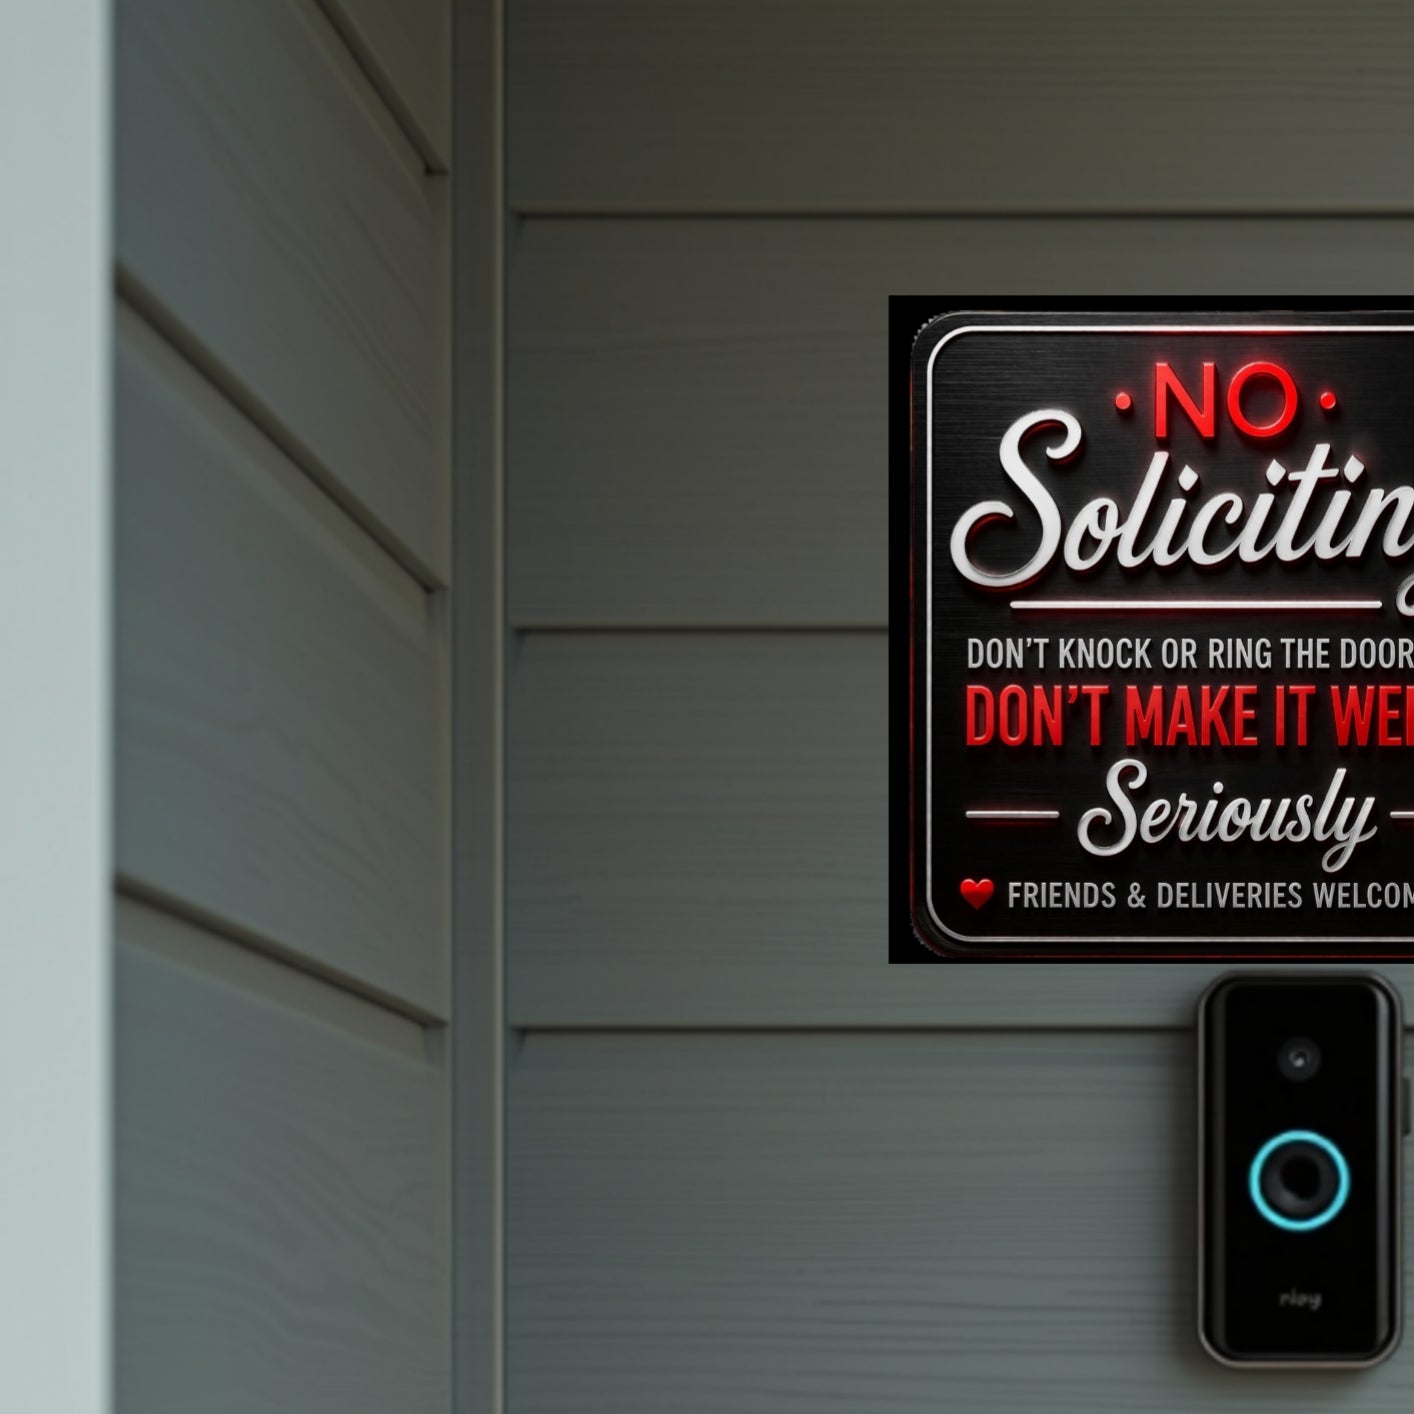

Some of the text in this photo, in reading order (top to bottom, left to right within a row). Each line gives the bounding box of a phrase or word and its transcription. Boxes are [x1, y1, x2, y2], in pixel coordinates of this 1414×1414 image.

[1154, 360, 1298, 438] NO
[967, 637, 1049, 669] DON'T
[1059, 637, 1151, 669] KNOCK
[1161, 637, 1198, 669] OR
[1208, 637, 1271, 669] RING
[1280, 637, 1329, 669] THE
[966, 684, 1109, 746] DON'T
[1126, 684, 1258, 746] MAKE
[1275, 684, 1316, 746] IT
[1077, 758, 1377, 872] Seriously
[1008, 882, 1115, 908] FRIENDS
[1127, 882, 1146, 908] &
[1157, 882, 1303, 908] DELIVERIES
